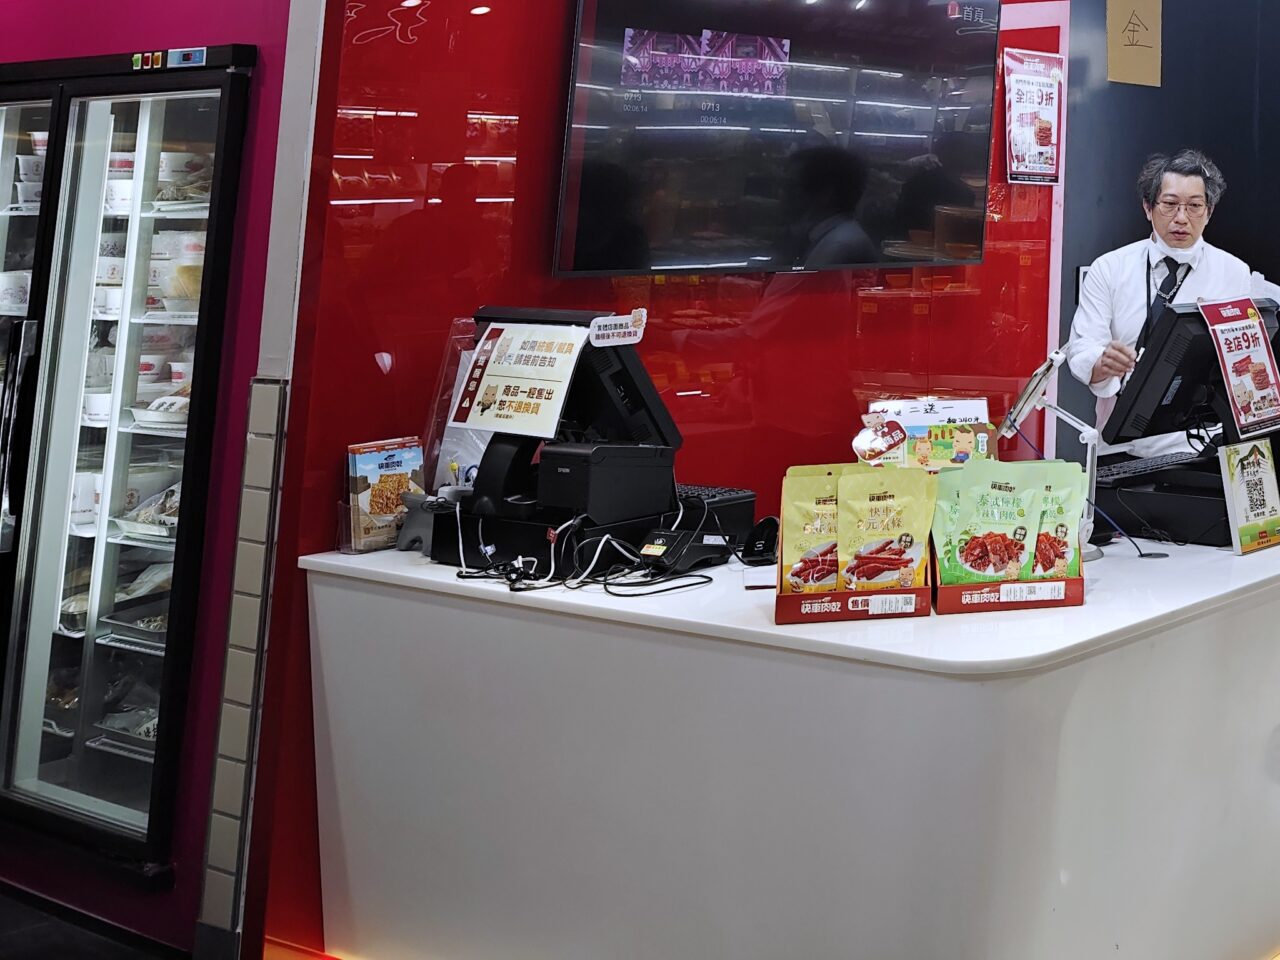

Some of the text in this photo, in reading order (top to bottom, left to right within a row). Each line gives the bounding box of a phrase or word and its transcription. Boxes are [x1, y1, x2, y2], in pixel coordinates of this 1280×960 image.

[963, 5, 984, 23] 首頁
[624, 93, 641, 102] 0713
[1015, 88, 1054, 107] 全店9折
[701, 102, 720, 112] 0713
[700, 116, 727, 124] 00:06:14
[1224, 331, 1261, 353] 全店9折
[513, 354, 557, 368] 請提前告知
[502, 385, 555, 401] 商品一經售出
